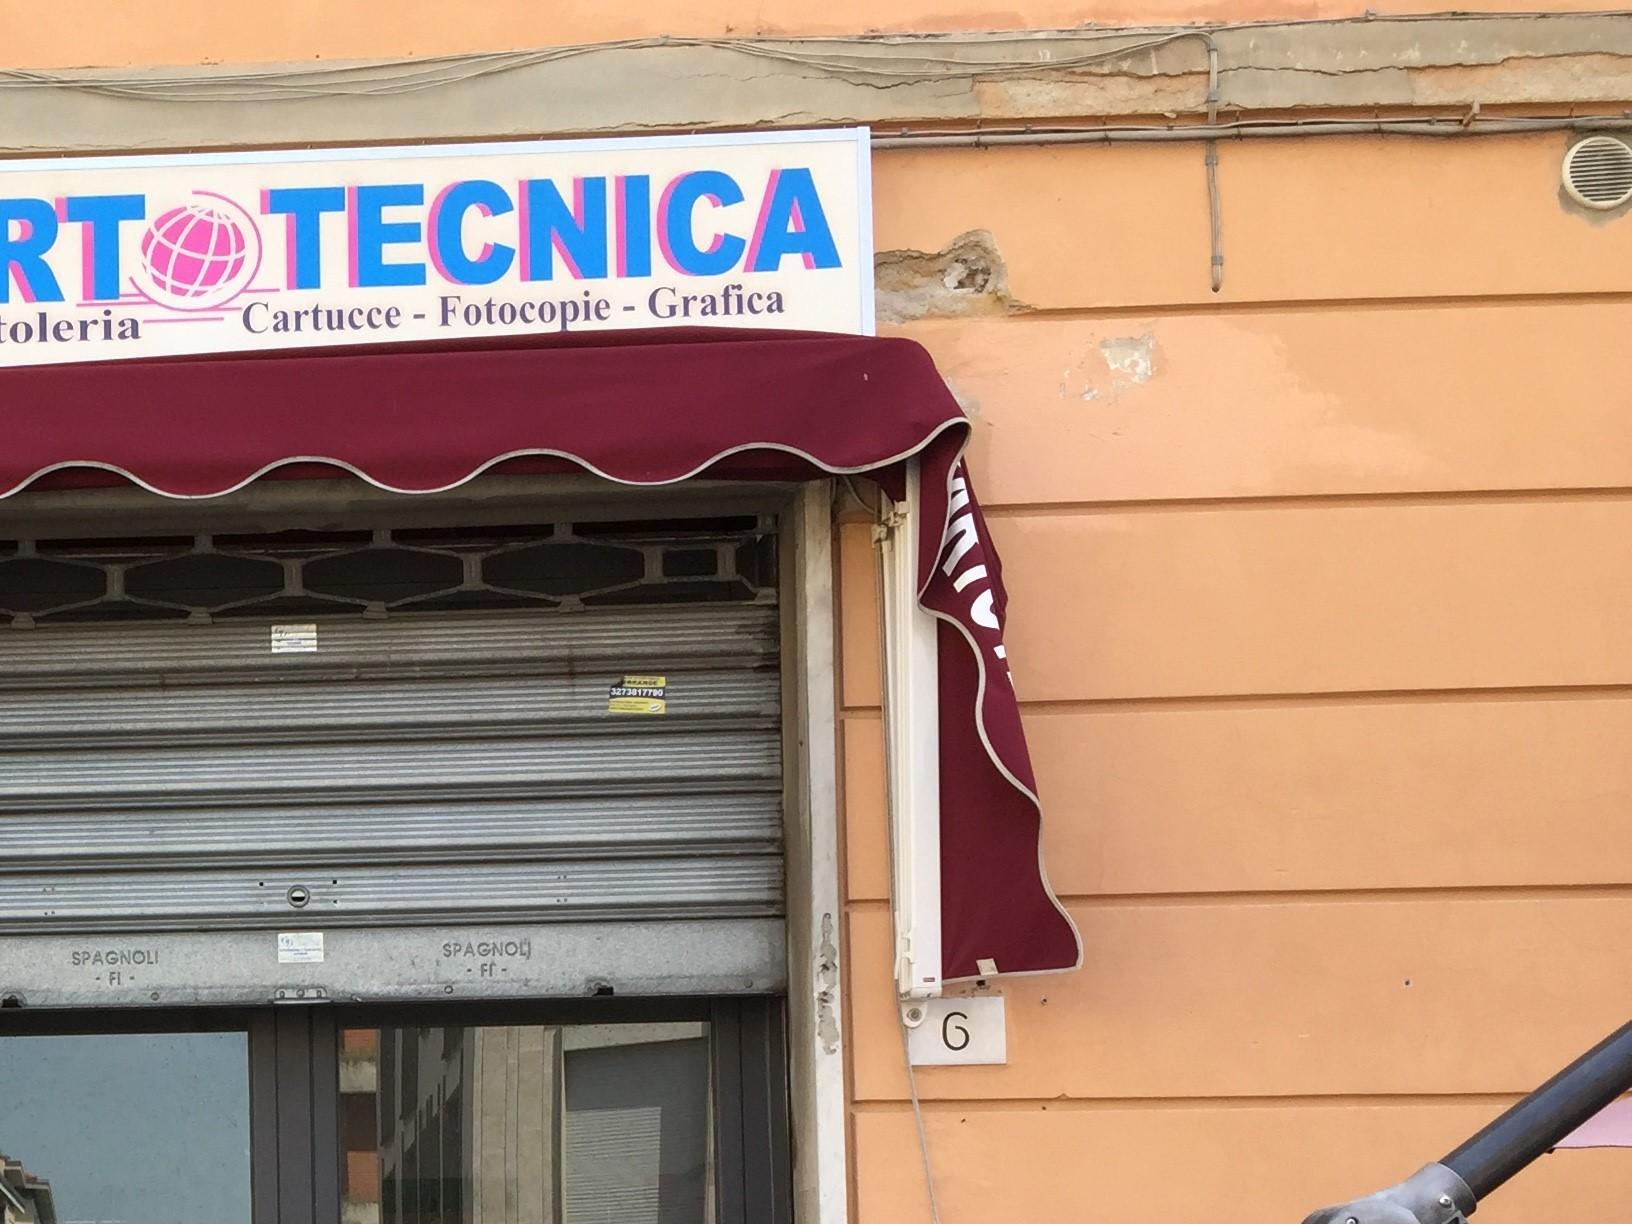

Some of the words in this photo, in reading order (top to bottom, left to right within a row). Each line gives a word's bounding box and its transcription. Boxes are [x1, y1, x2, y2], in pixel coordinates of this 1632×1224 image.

[242, 301, 402, 334] Cartucce
[438, 290, 611, 331] Fotocopie
[647, 284, 786, 319] Grafica
[71, 948, 159, 966] SPAGNOLI
[442, 940, 532, 960] SPAGNOLI
[942, 1011, 970, 1051] 6
